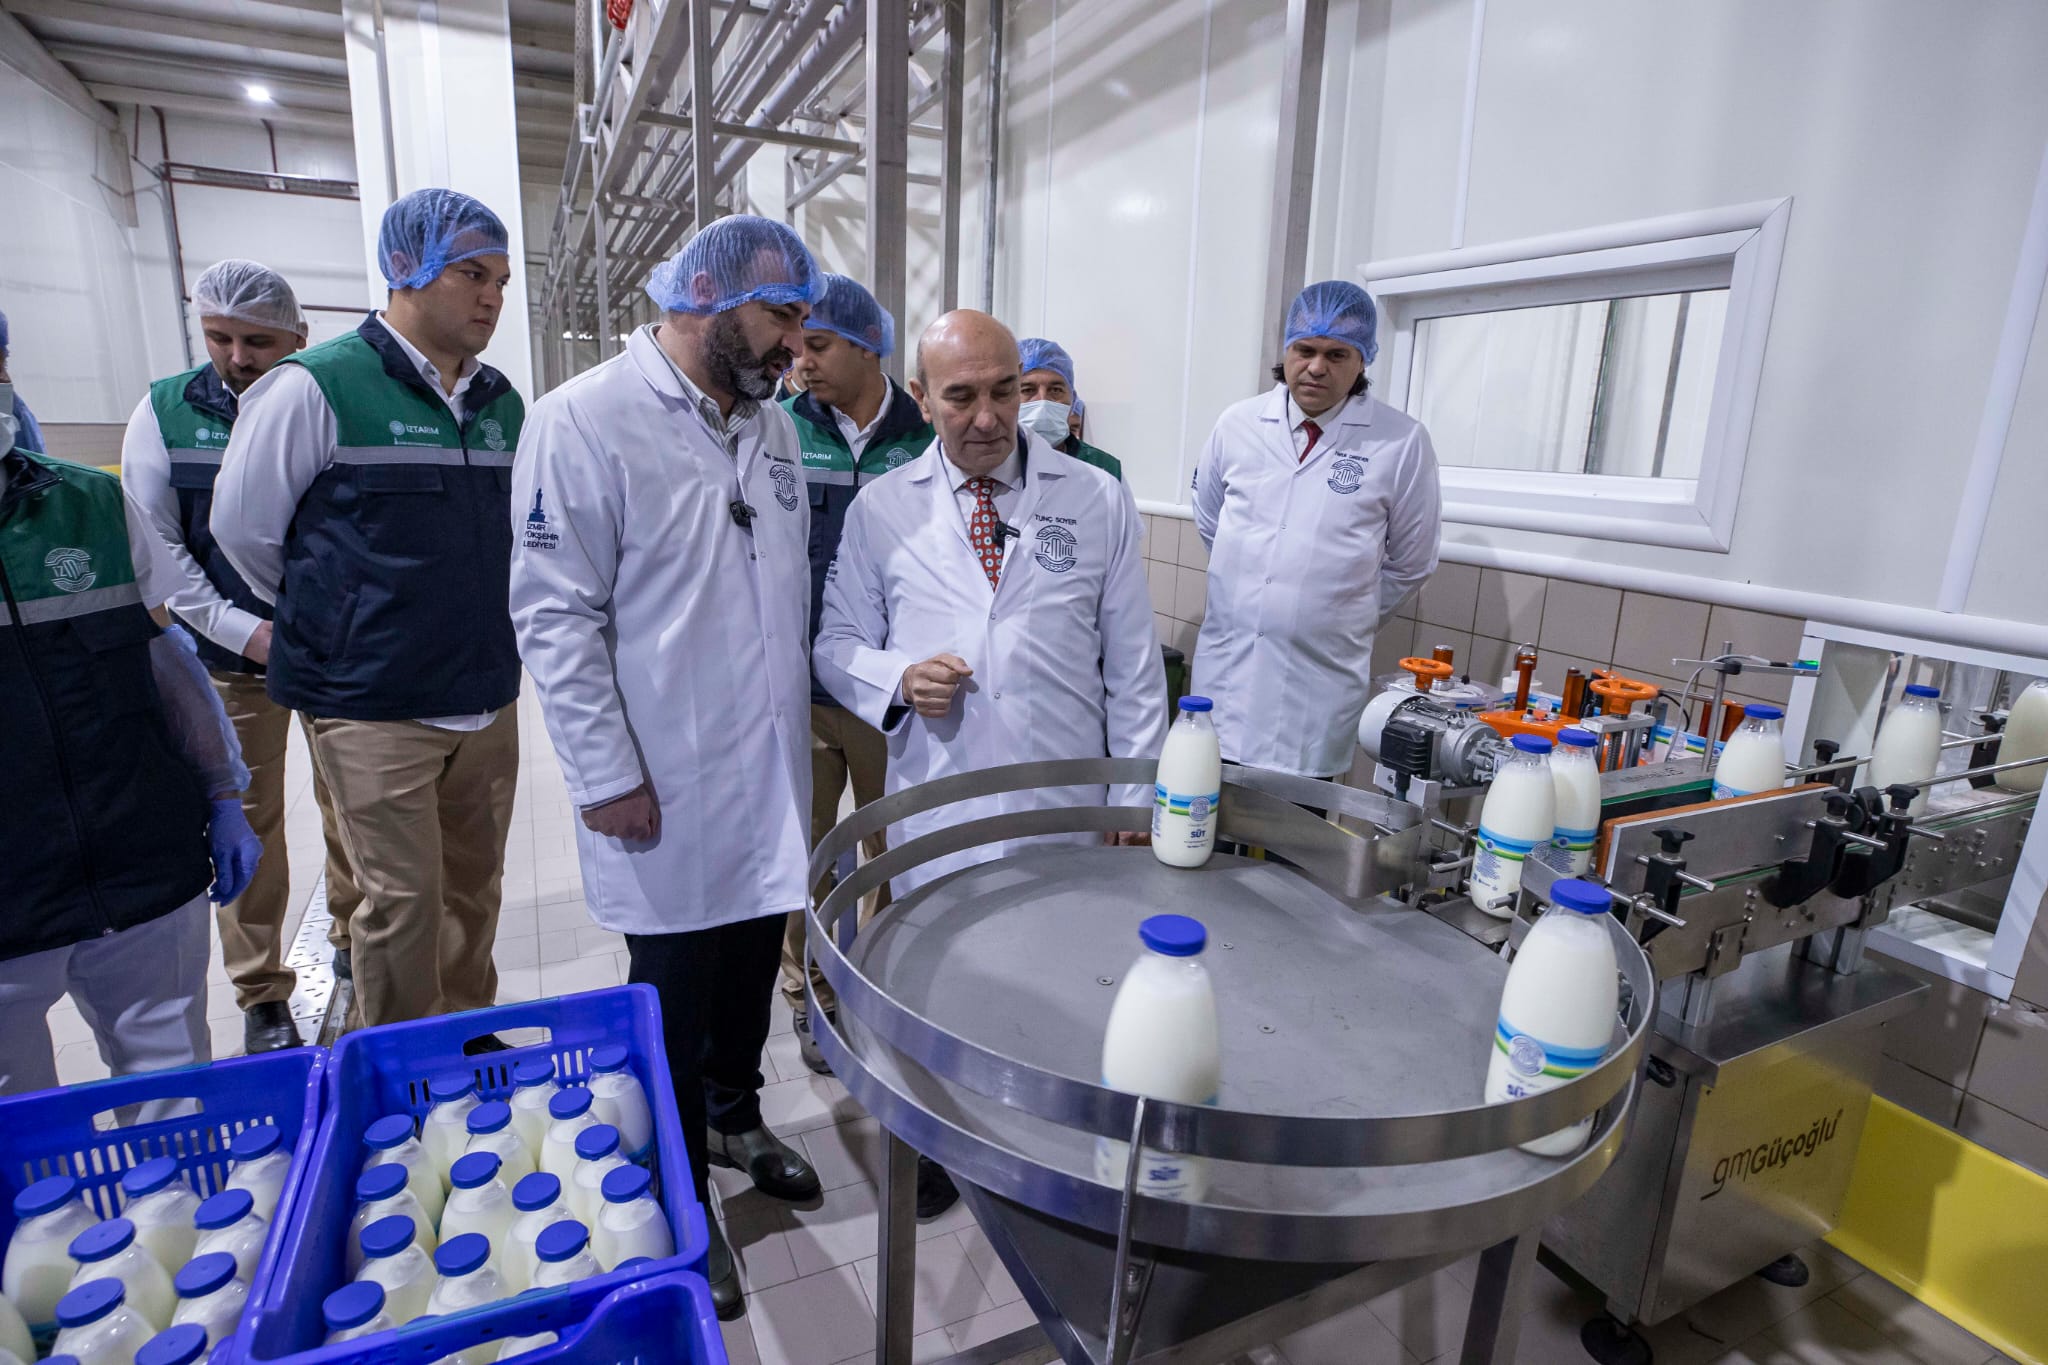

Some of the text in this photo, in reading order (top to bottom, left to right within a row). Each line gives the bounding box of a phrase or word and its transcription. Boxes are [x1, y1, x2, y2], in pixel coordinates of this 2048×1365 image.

[1055, 517, 1077, 525] SOYER
[525, 530, 559, 541] ÜKŞEHİR
[523, 540, 556, 550] LEDİYESİ
[1190, 829, 1207, 838] SÜT
